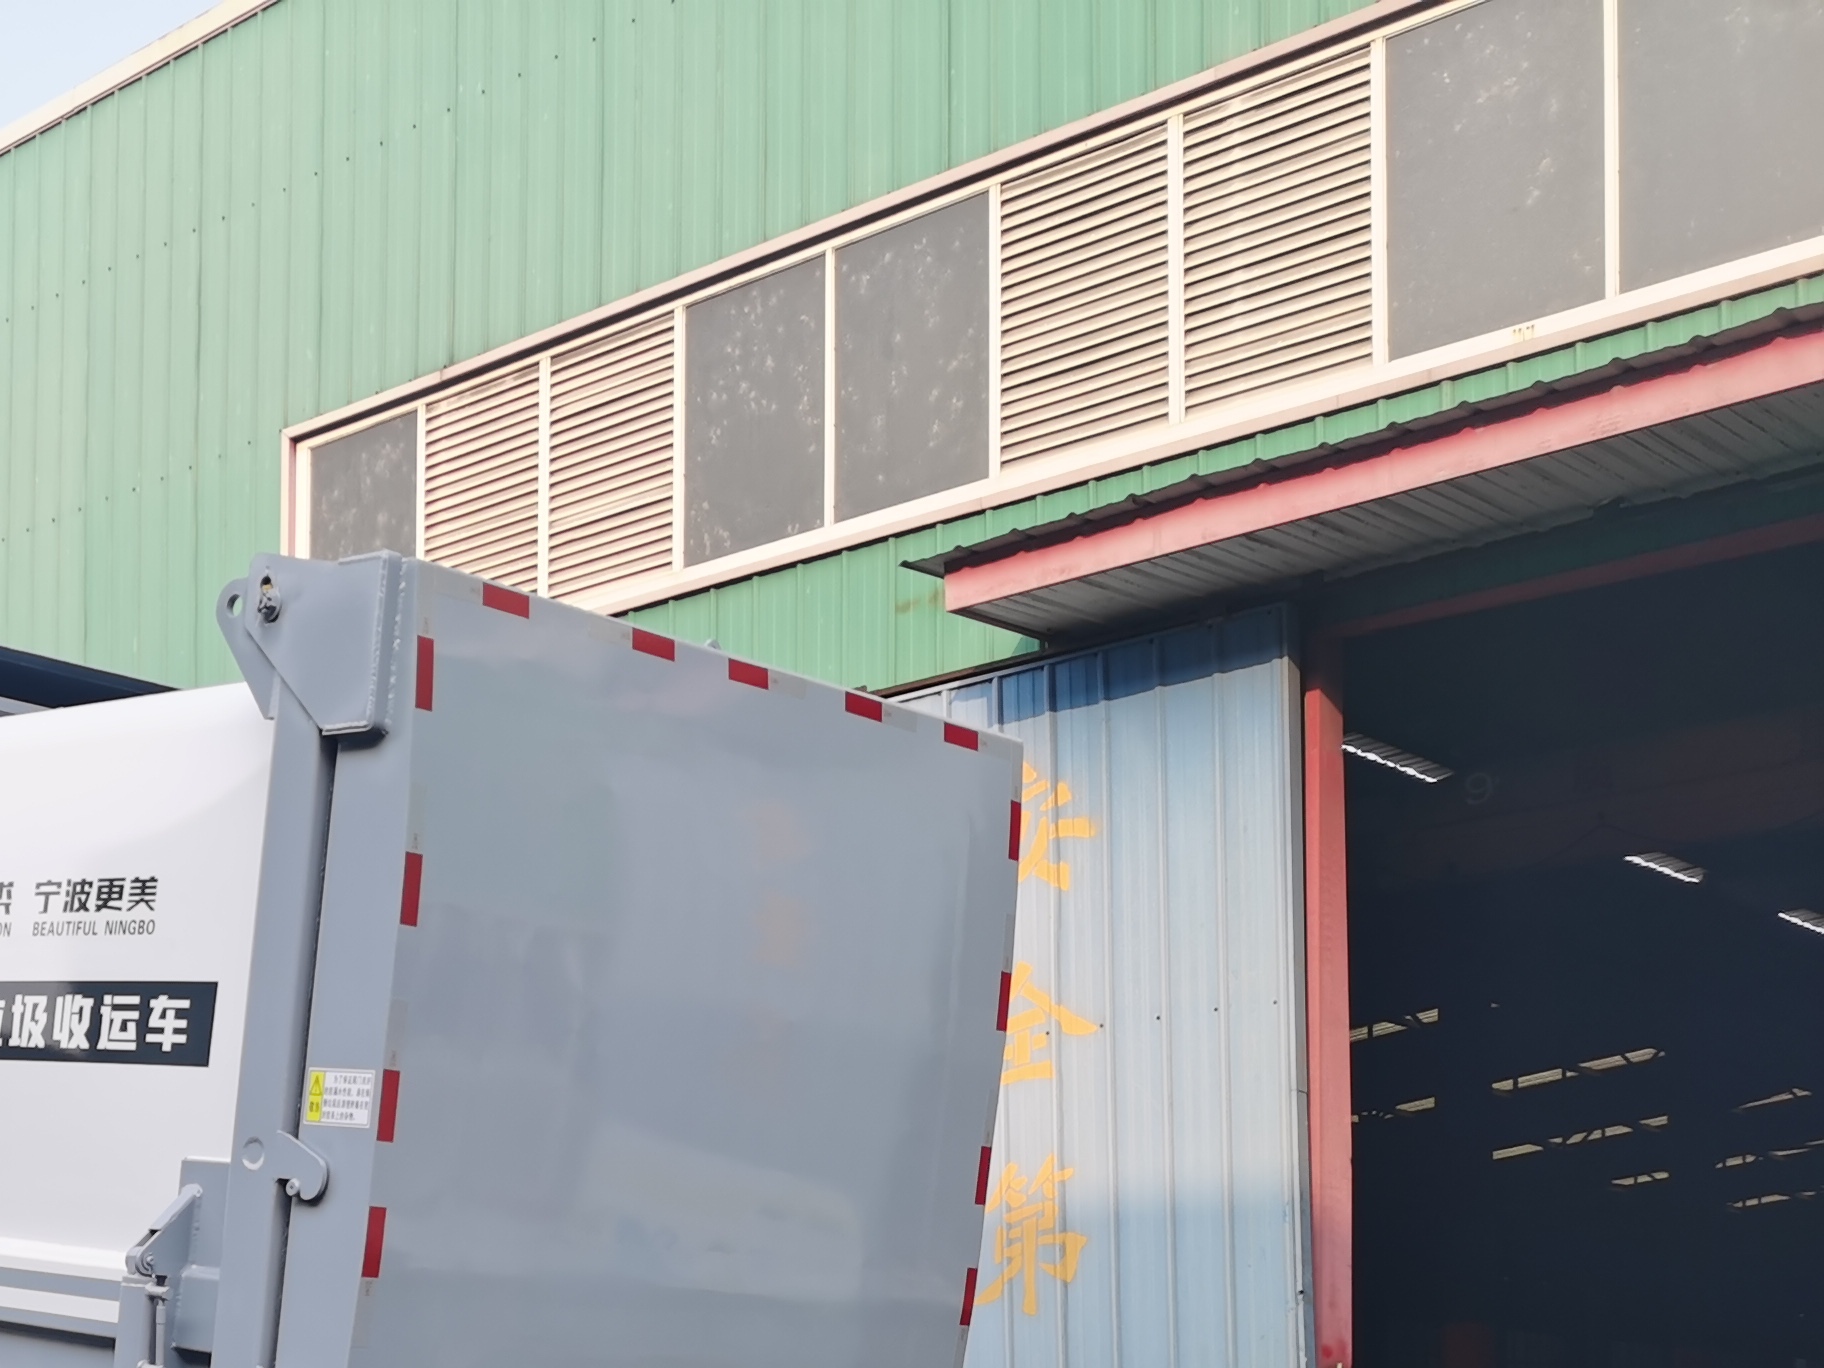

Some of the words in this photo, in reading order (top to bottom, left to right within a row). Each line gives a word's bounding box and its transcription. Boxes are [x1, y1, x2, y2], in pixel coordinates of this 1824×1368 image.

[34, 876, 159, 914] 宁波更美
[32, 921, 98, 936] BEAUTIFUL
[104, 919, 156, 936] NINGBO
